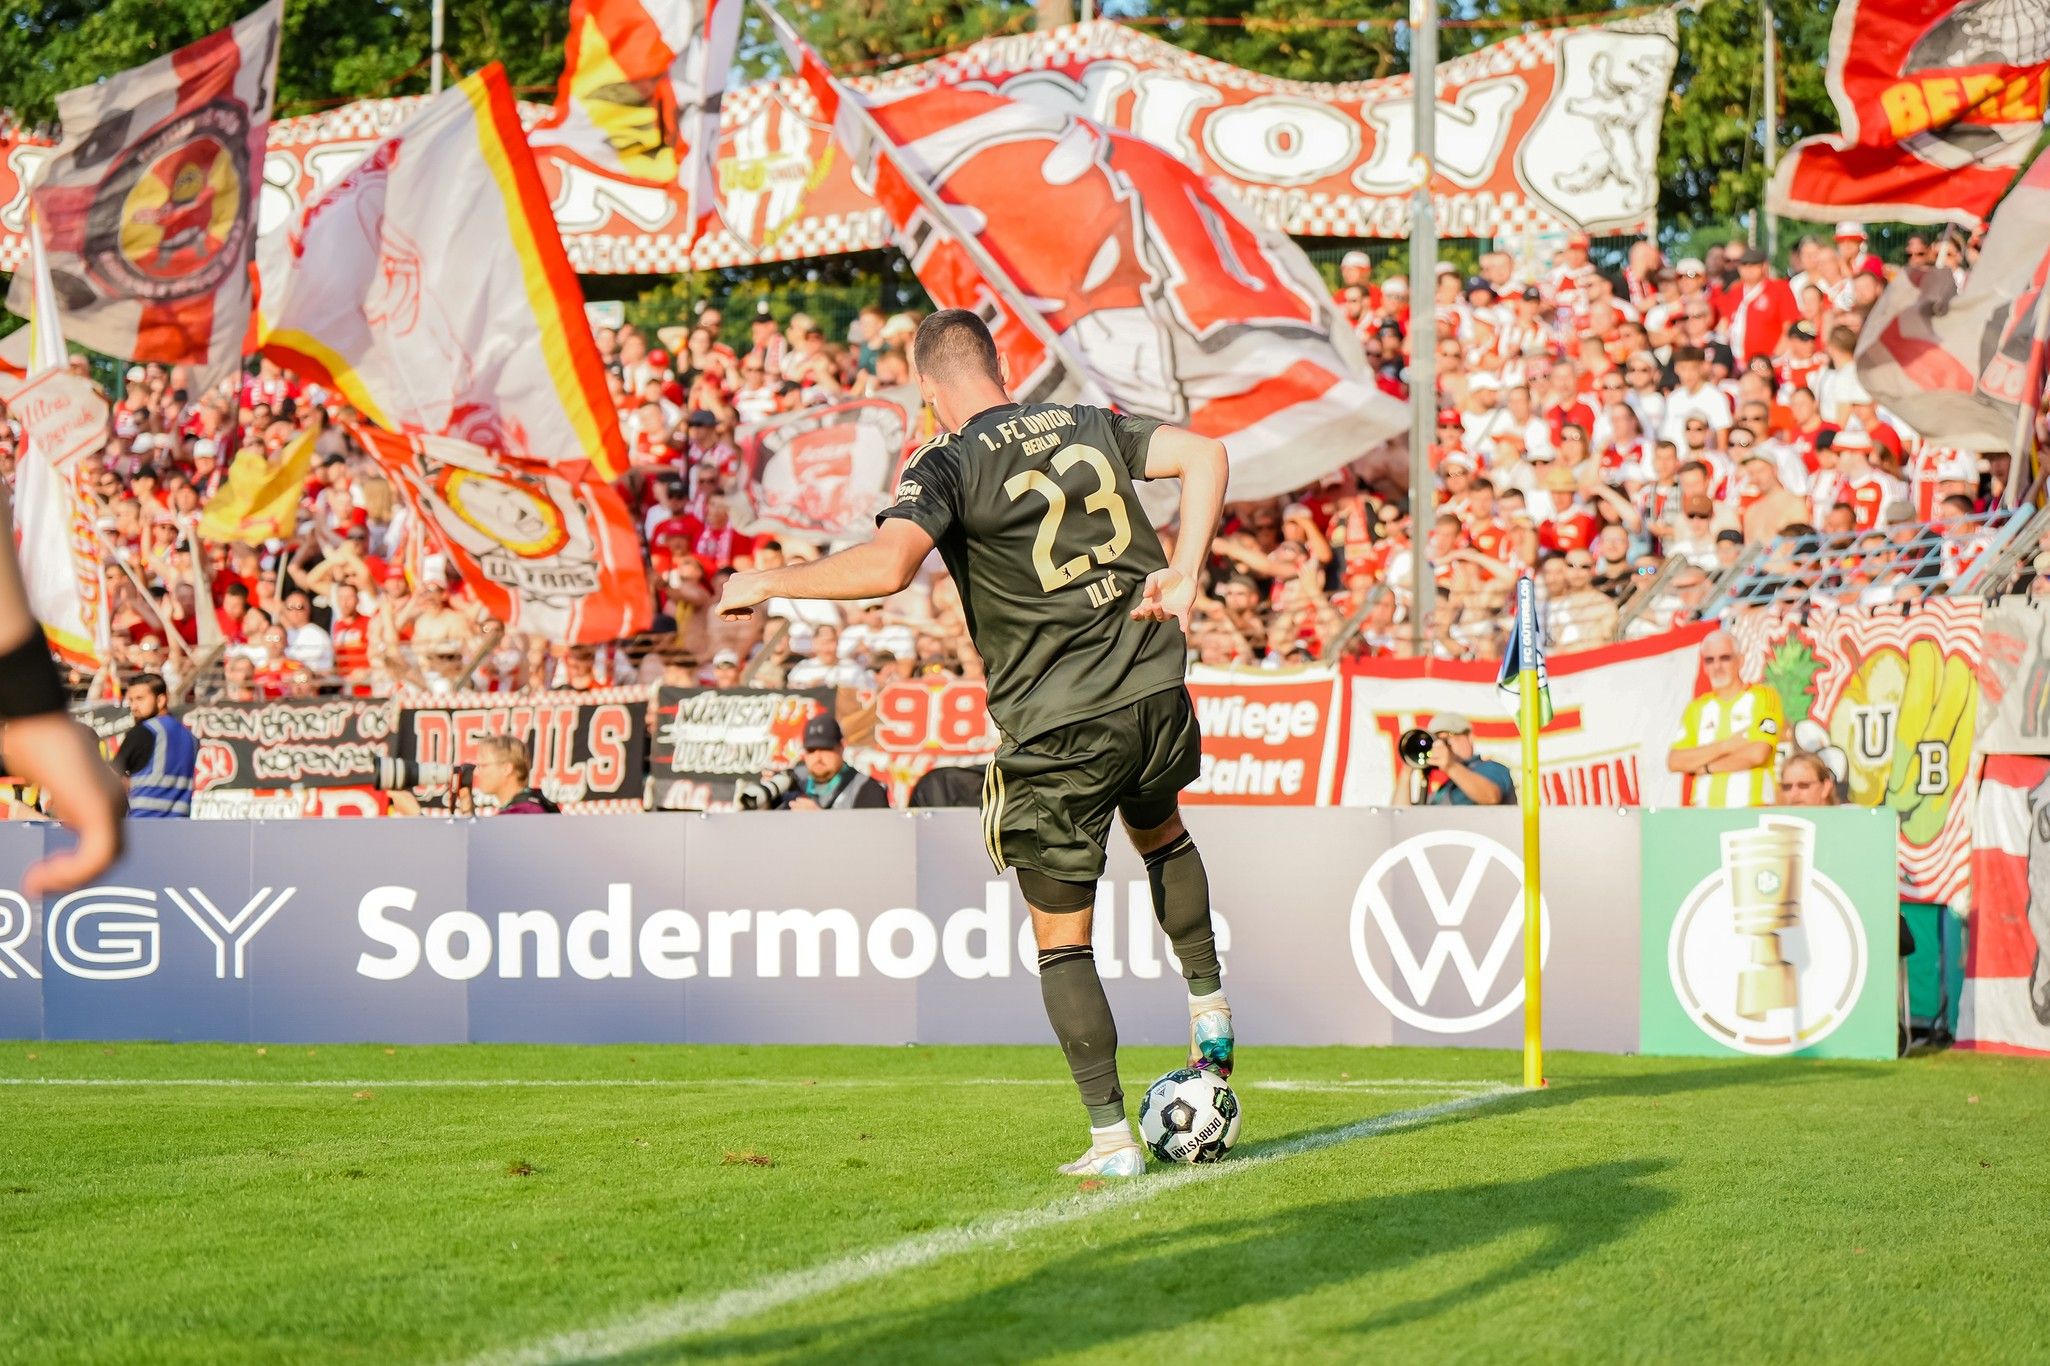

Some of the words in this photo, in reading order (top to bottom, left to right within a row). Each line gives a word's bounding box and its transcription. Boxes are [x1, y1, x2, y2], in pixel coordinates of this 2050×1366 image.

[979, 432, 1001, 452] 1.
[996, 419, 1026, 444] FC
[1020, 409, 1077, 440] UNION
[1021, 432, 1062, 457] BERLIN
[1003, 443, 1132, 593] 23
[1085, 570, 1123, 609] ILIĆ
[1197, 695, 1319, 745] Wiege
[1171, 1116, 1222, 1160] DERBYSTAR
